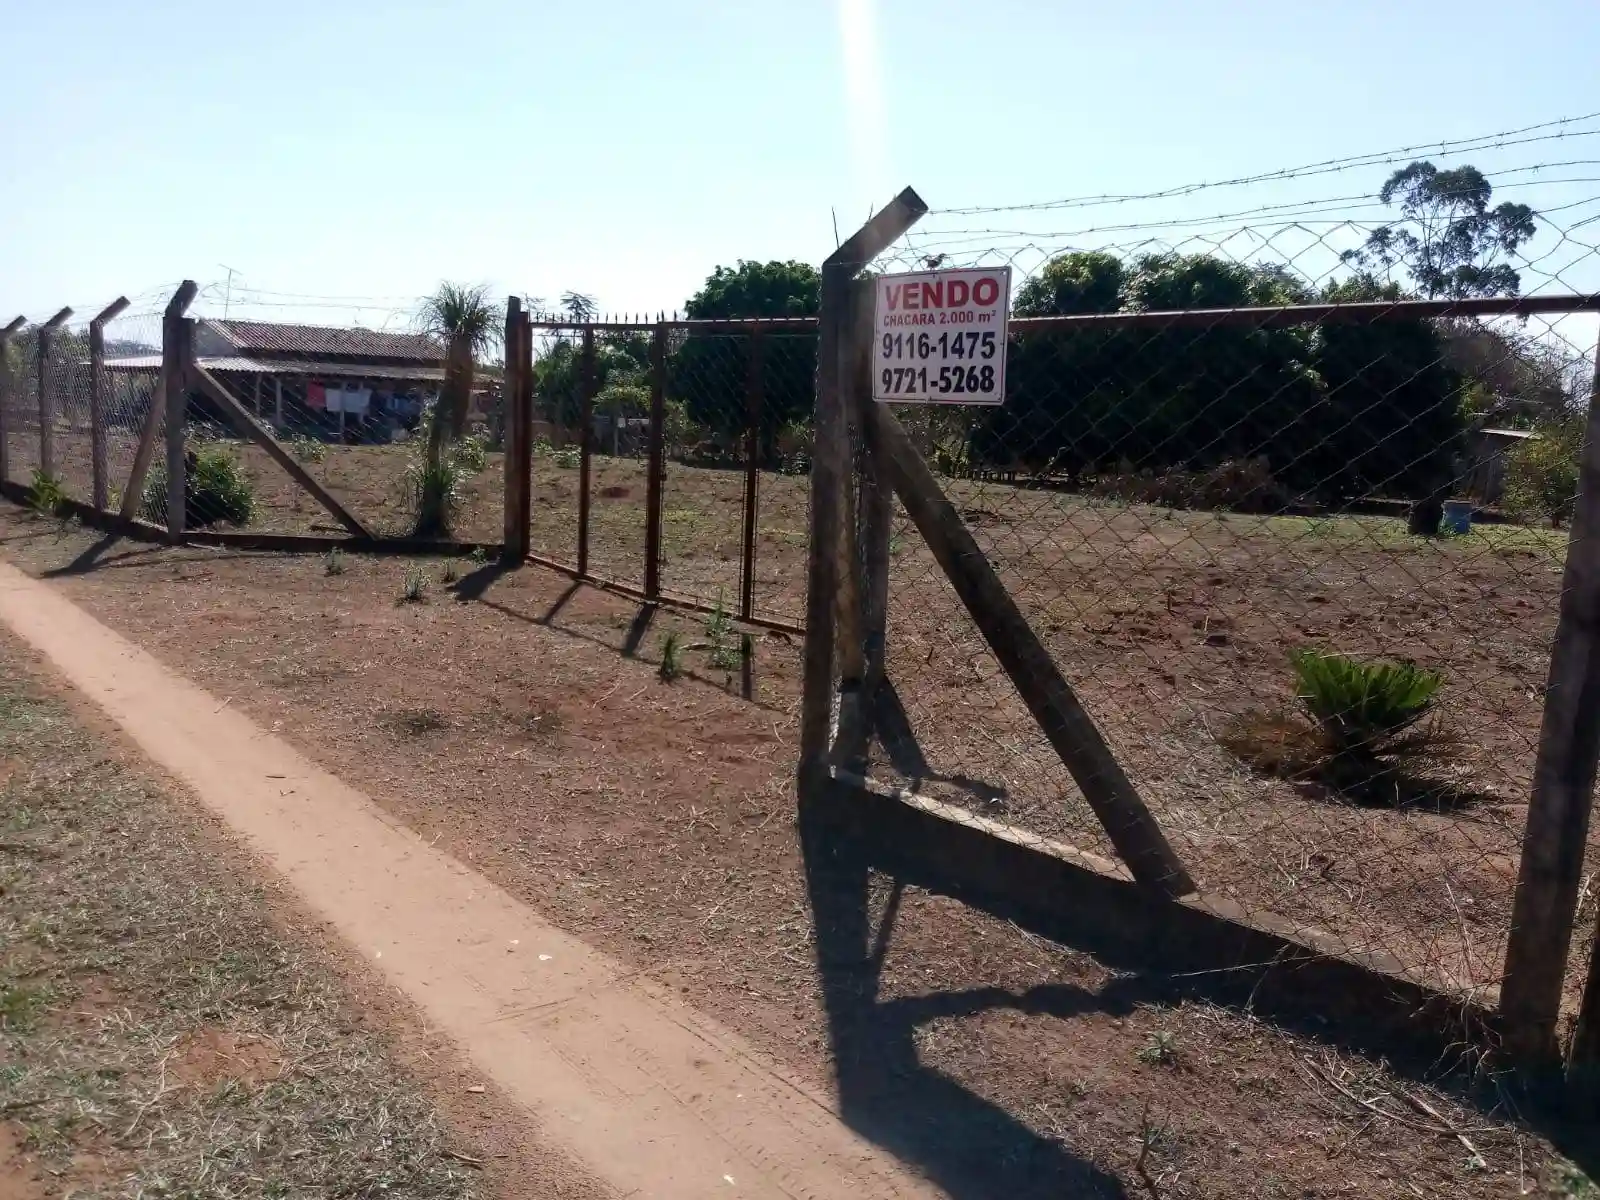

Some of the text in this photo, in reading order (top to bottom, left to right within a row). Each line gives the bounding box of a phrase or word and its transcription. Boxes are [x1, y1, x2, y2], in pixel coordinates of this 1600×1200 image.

[885, 277, 999, 311] VENDO
[883, 314, 936, 328] CHACARA
[939, 311, 974, 325] 2.000
[882, 331, 996, 360] 9116-1475
[881, 364, 995, 394] 9721-5268
